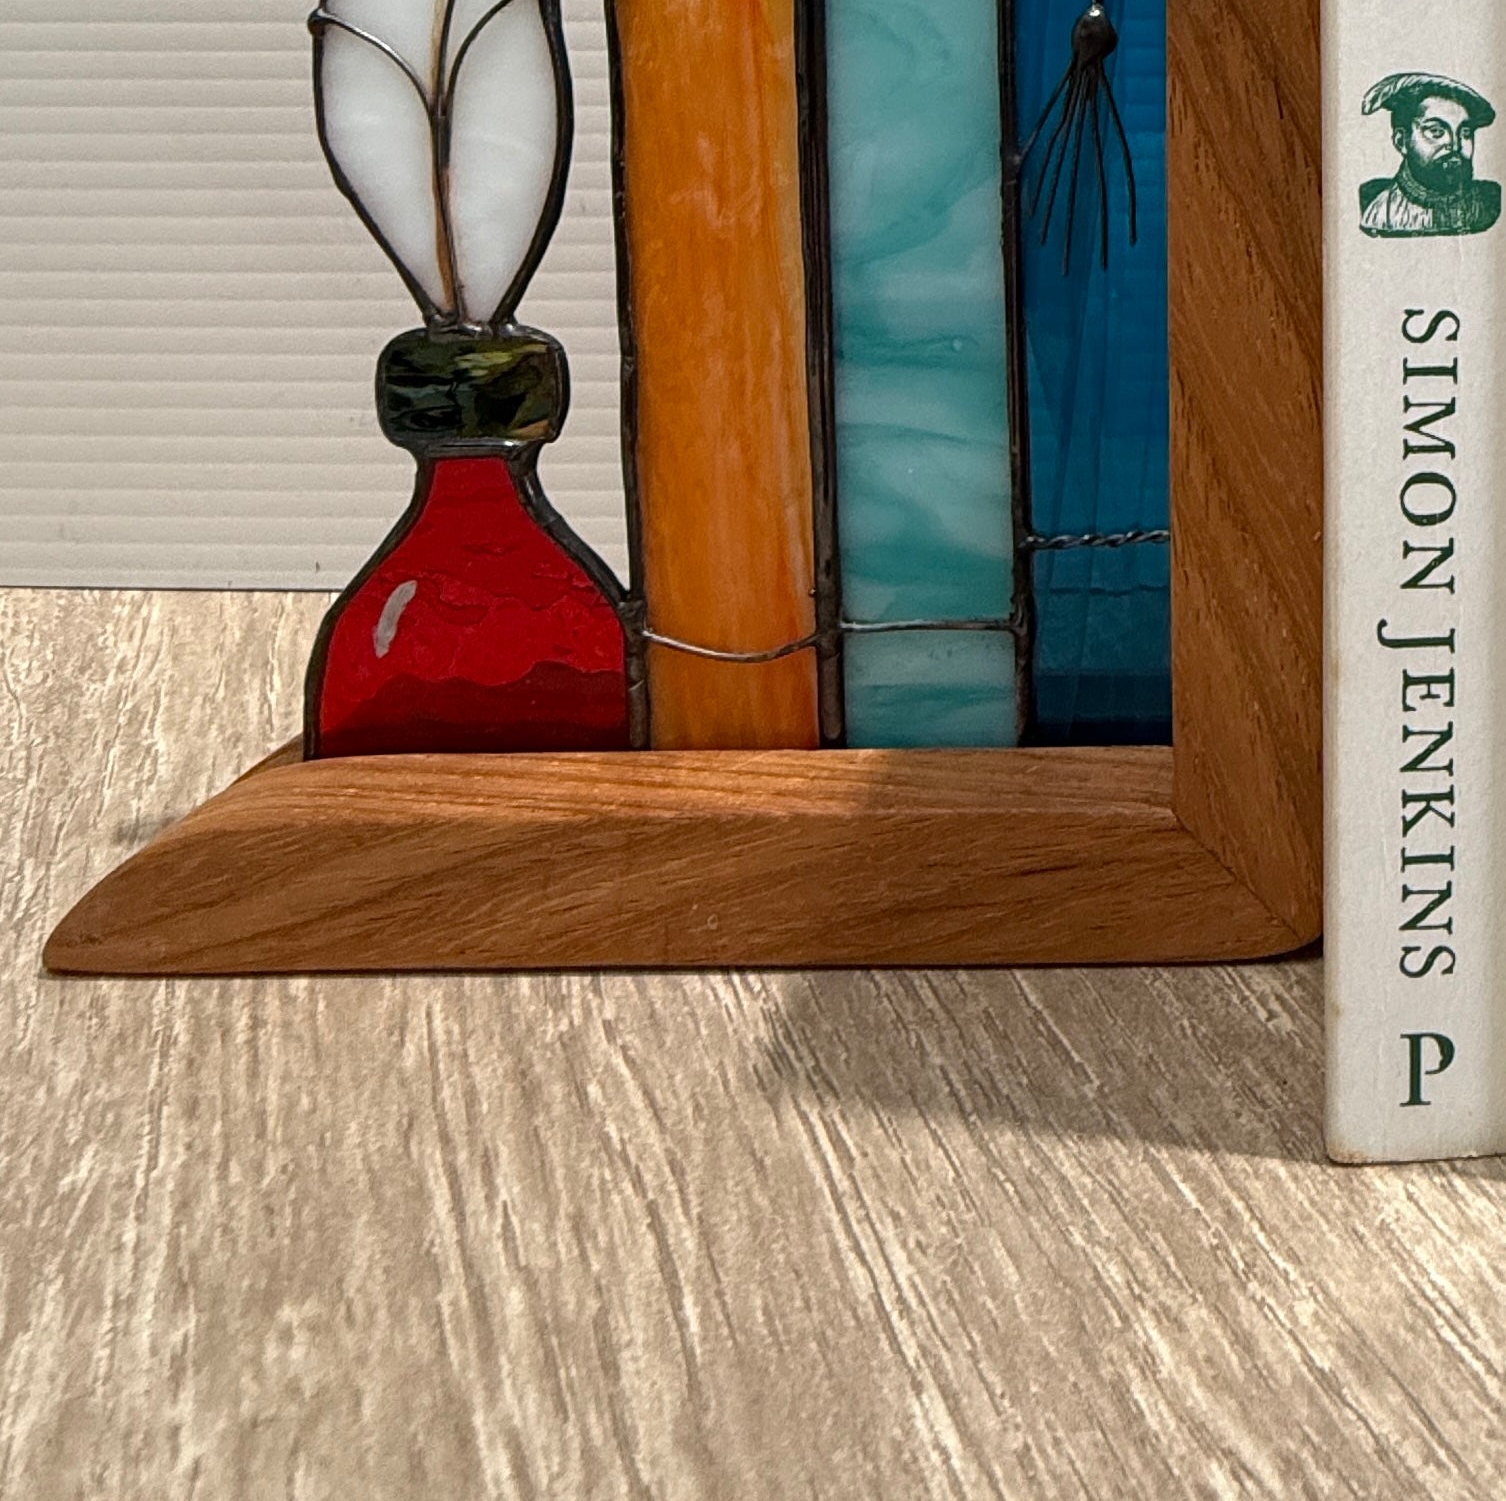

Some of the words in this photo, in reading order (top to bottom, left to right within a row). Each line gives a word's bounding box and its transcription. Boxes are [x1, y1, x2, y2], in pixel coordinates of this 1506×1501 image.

[1399, 308, 1460, 595] SIMON
[1376, 617, 1459, 981] JENKINS
[1399, 1032, 1456, 1107] P
